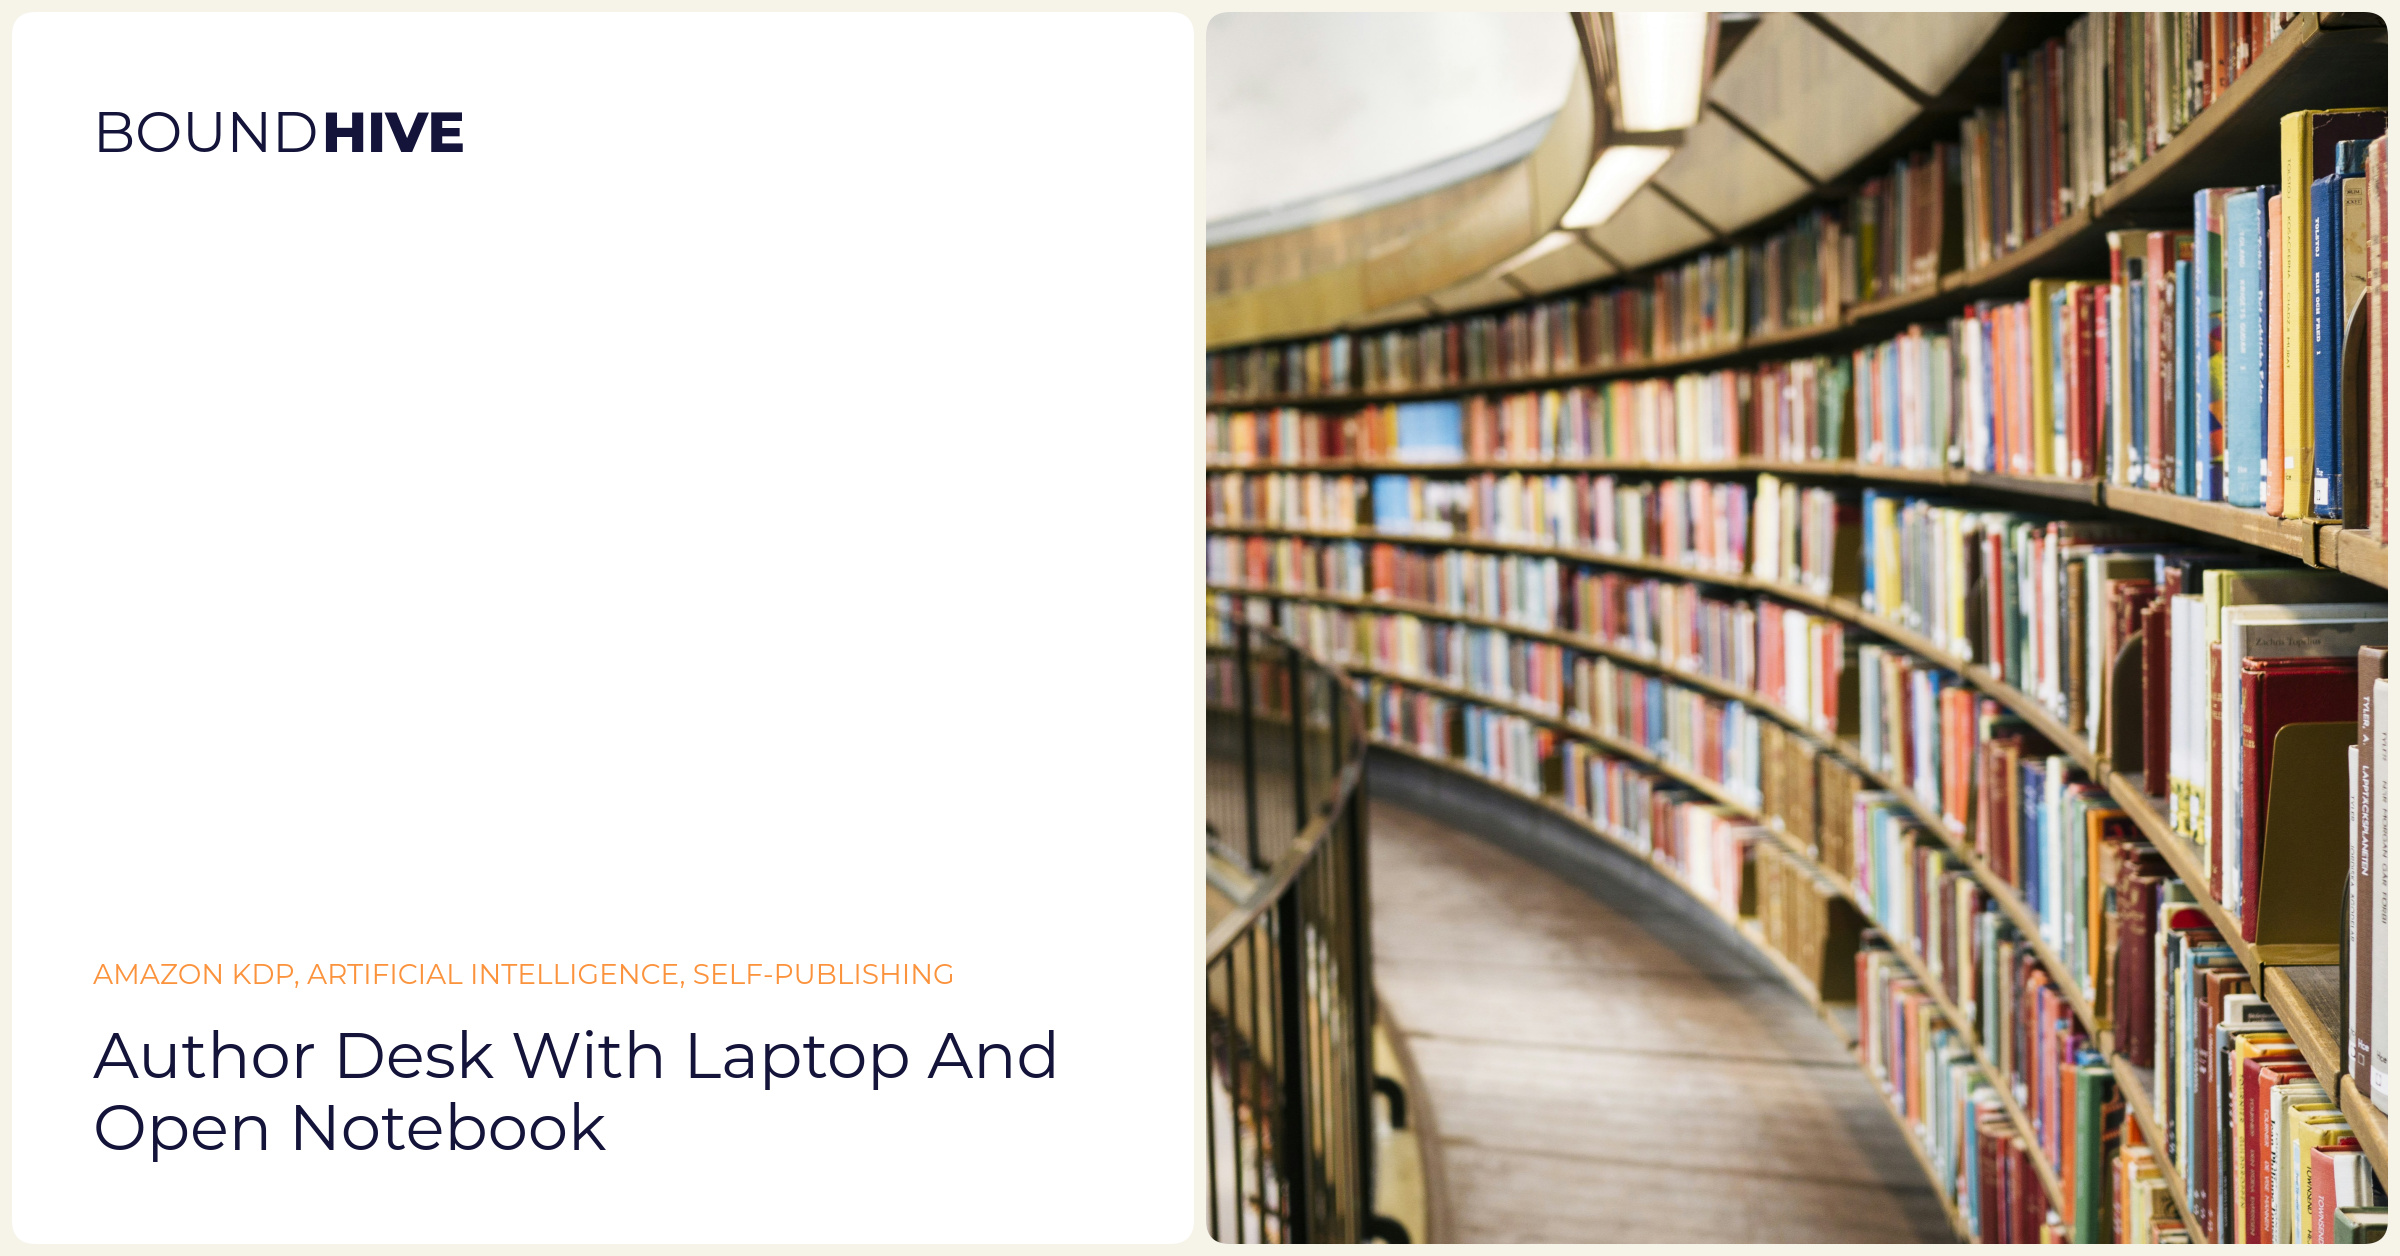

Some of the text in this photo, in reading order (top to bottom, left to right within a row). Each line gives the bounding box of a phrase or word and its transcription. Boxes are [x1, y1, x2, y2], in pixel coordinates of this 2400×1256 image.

[2361, 696, 2371, 730] TYLER,
[2361, 733, 2371, 746] A.
[2317, 1194, 2325, 1244] TOWNSEND
